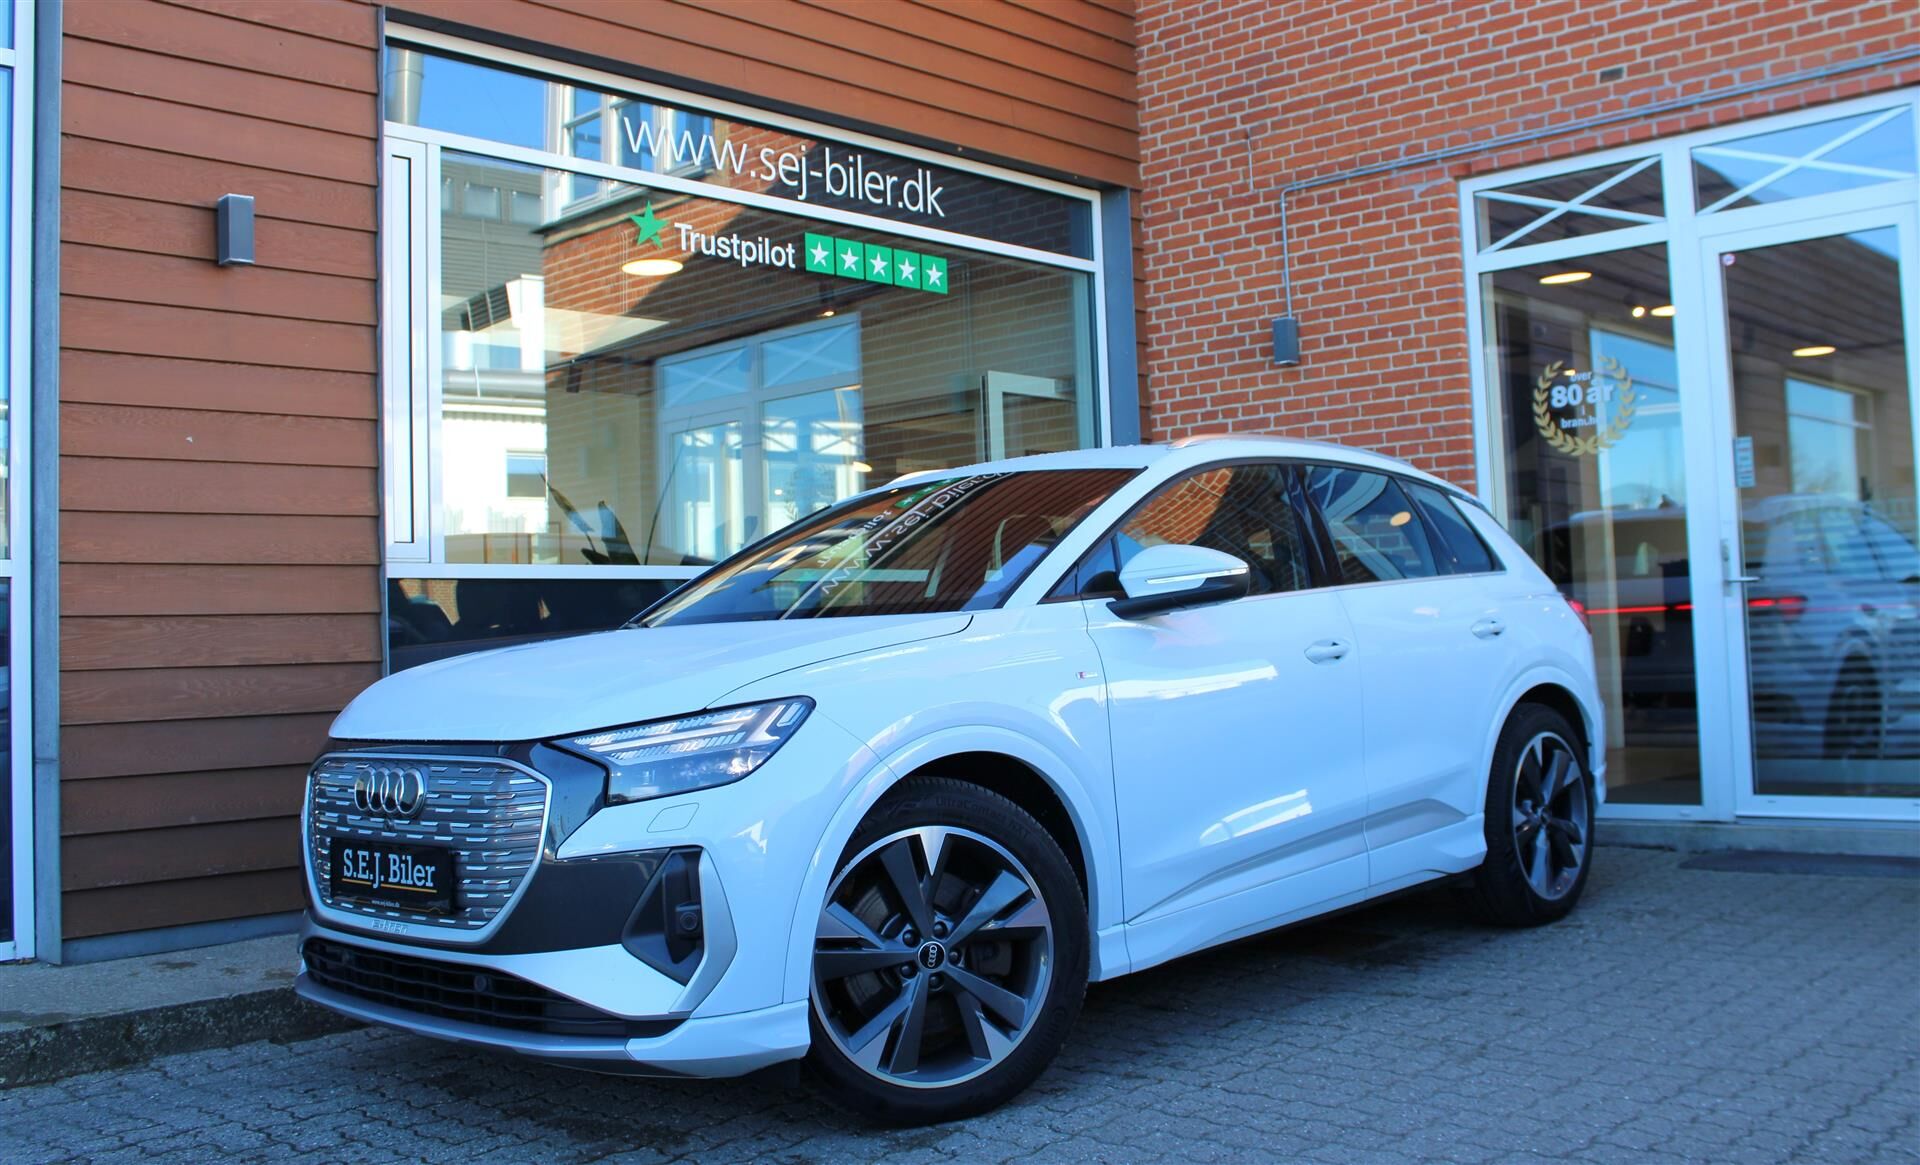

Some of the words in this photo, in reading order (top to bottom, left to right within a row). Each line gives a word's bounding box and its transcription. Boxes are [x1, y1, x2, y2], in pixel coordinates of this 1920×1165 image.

[623, 116, 945, 217] www.sej-biler.dk
[673, 221, 796, 270] Trustpilot
[1551, 384, 1584, 408] 80
[343, 848, 385, 889] S.E.J.
[388, 853, 436, 887] Biler
